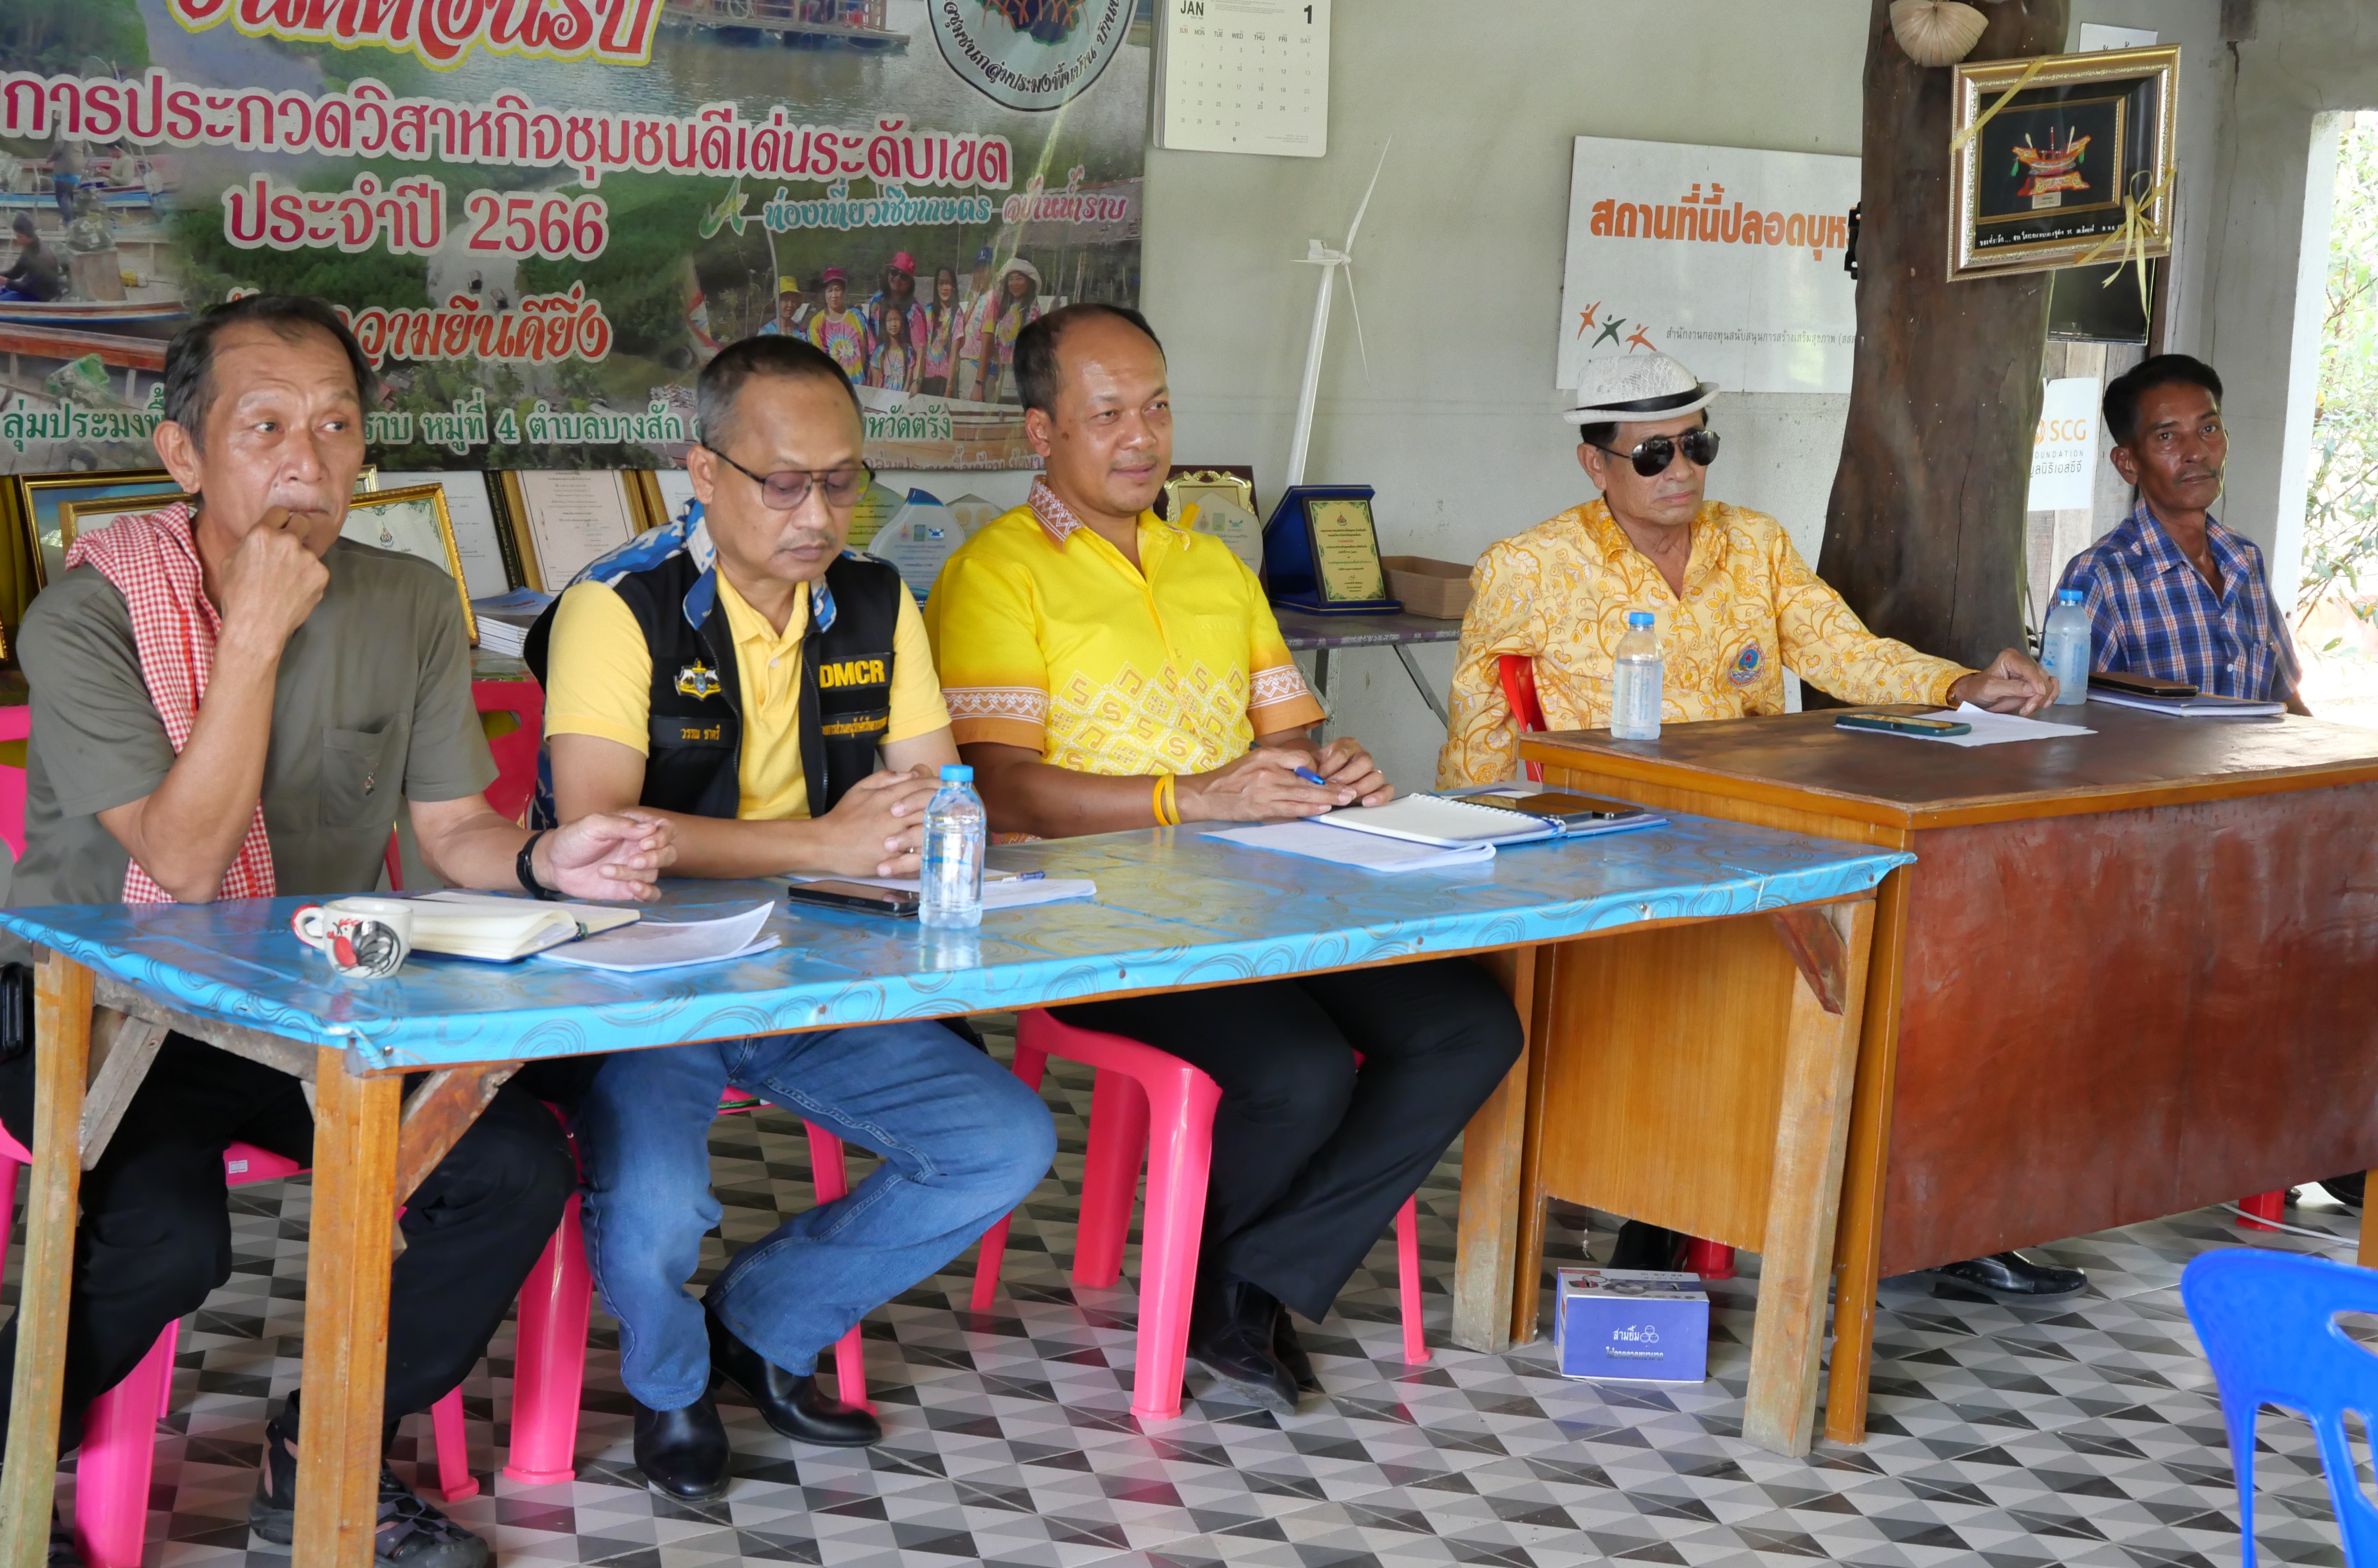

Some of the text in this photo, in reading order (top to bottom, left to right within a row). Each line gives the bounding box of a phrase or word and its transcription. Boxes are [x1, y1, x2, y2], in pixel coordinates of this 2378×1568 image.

[1180, 0, 1204, 16] JAN
[1304, 5, 1312, 24] 1
[0, 75, 1007, 183] การประกวดวิสาหกิจชุมชนดีเด่นระดับเขต
[231, 178, 603, 254] ประจำปี 2566
[766, 177, 990, 230] ท่องเที่ยวเชิงเกษตร
[1590, 183, 1850, 261] สถานที่นี้ปลอดบุห
[338, 283, 607, 365] วามยินดียิ่ง
[3, 387, 164, 451] ลุ่มประมงพื้
[423, 390, 485, 451] หมู่ที่
[497, 416, 516, 441] 4
[529, 404, 681, 441] ตำบลบางสัก
[863, 404, 950, 439] หวัดตรัง
[2050, 419, 2087, 442] SCG
[2035, 449, 2084, 459] OUNDATION
[819, 659, 885, 688] DMCR
